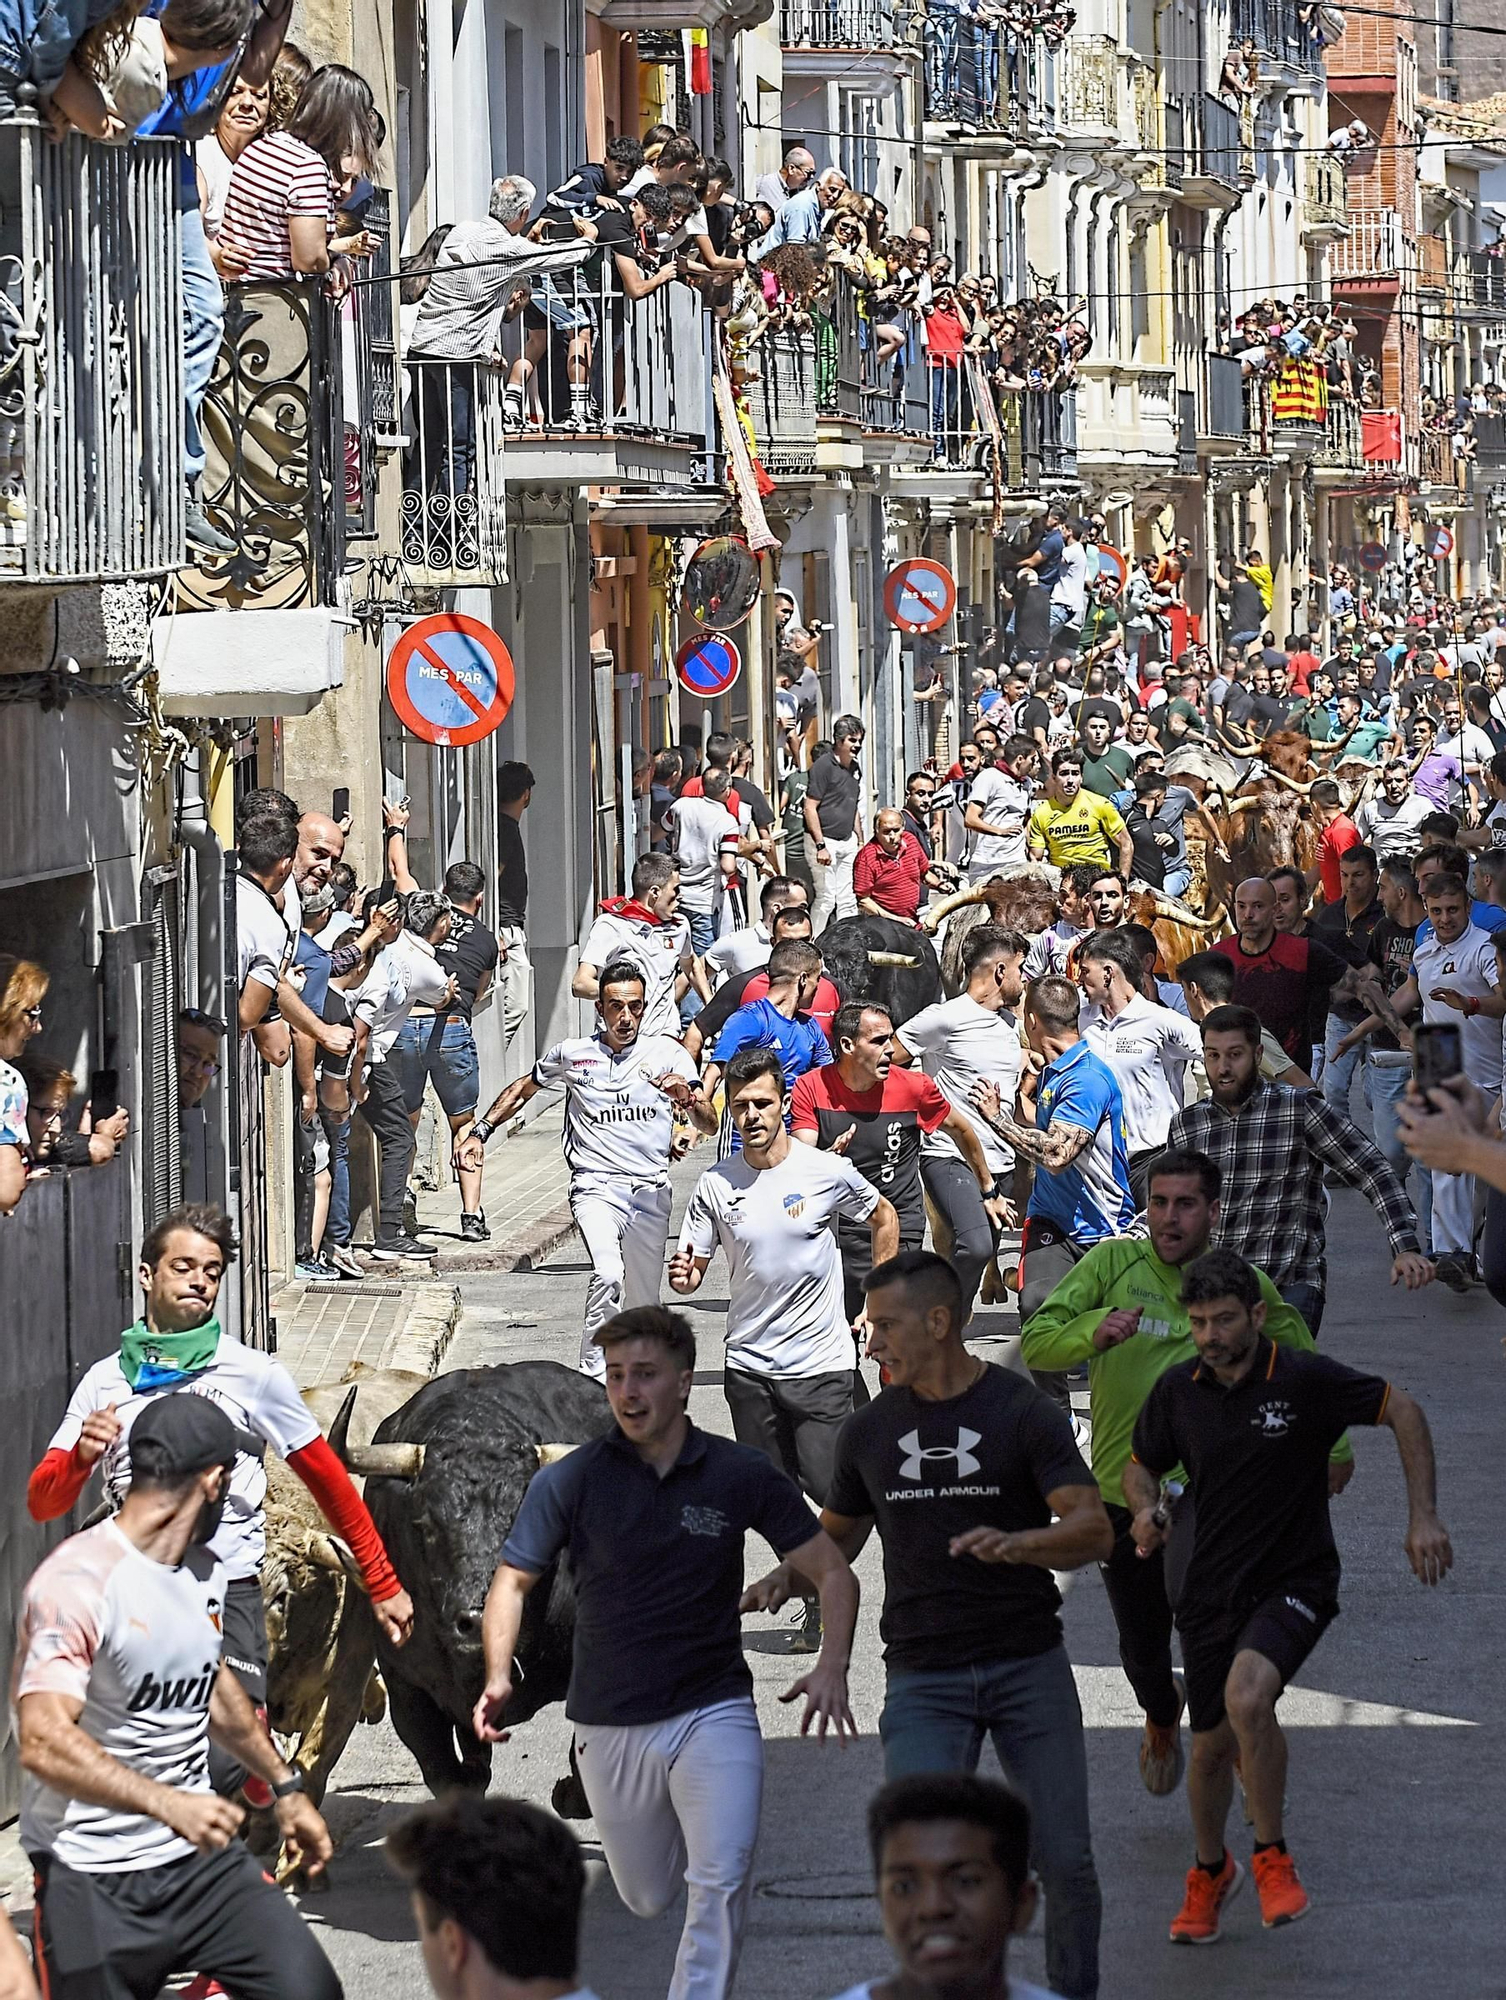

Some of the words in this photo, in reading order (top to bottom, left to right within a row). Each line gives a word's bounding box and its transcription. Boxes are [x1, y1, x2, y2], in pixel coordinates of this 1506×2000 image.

[691, 635, 708, 645] MES
[419, 667, 449, 680] MES
[455, 671, 482, 684] PAR
[1048, 824, 1090, 836] PAMESA
[1391, 937, 1413, 953] SHO
[572, 1060, 599, 1069] EMMA
[582, 1069, 590, 1077] &
[616, 1093, 630, 1105] ly
[885, 1488, 935, 1501] UNDER
[940, 1485, 1000, 1497] ARMOUR
